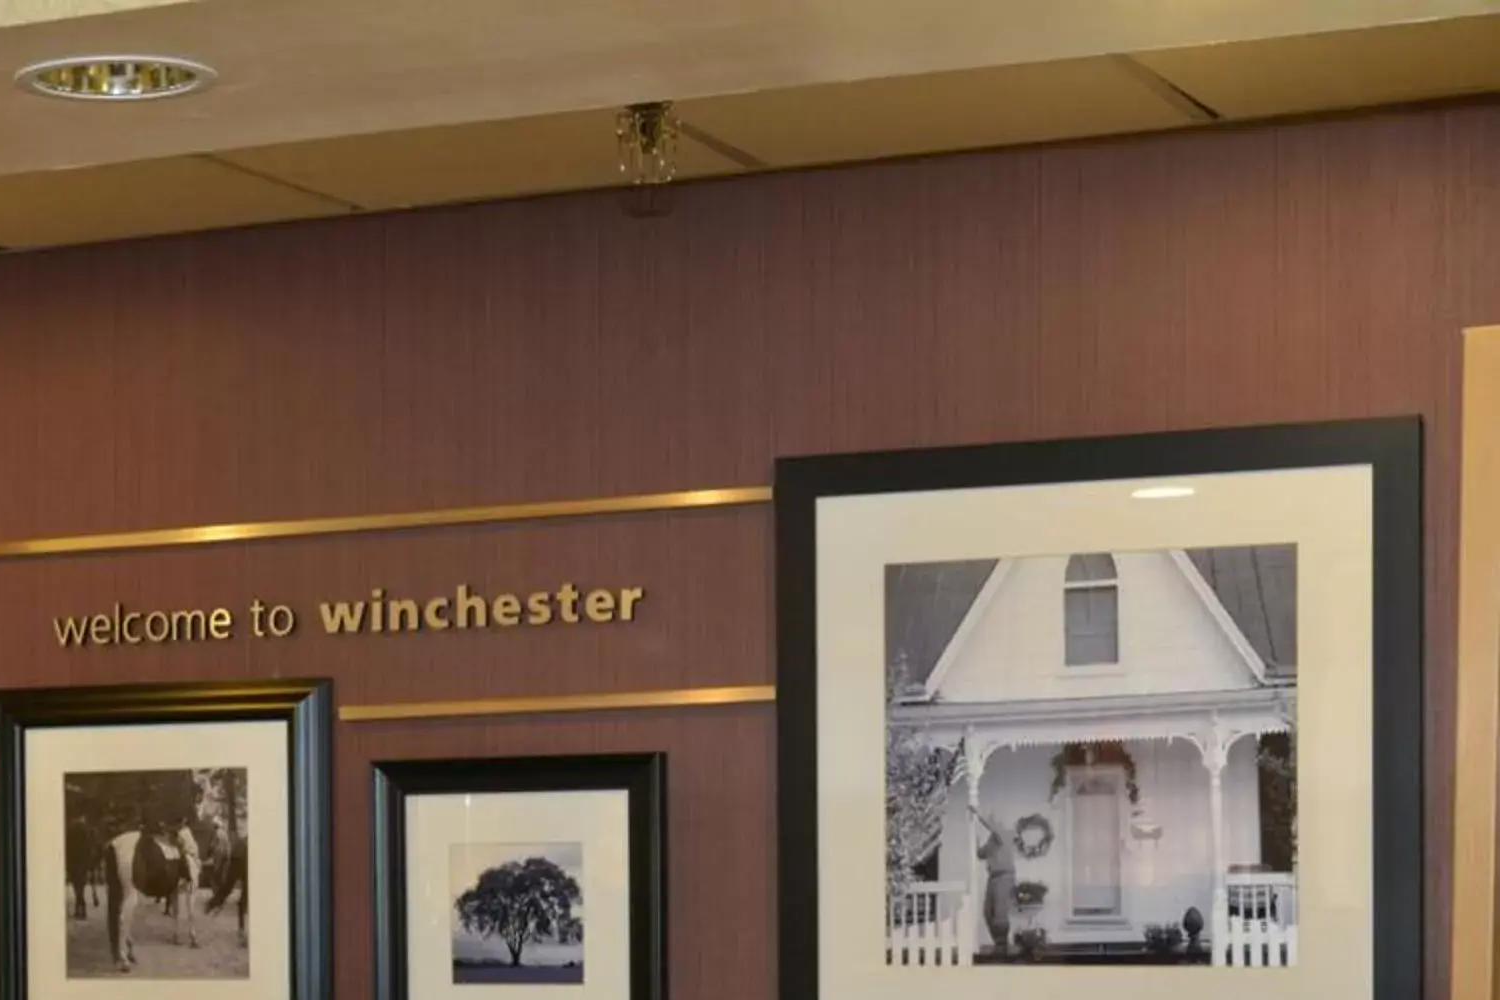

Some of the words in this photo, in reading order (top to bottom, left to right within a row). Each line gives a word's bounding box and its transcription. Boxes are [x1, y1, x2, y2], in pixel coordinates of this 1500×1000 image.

[53, 601, 232, 646] welcome
[250, 599, 294, 637] to
[319, 583, 643, 634] winchester
